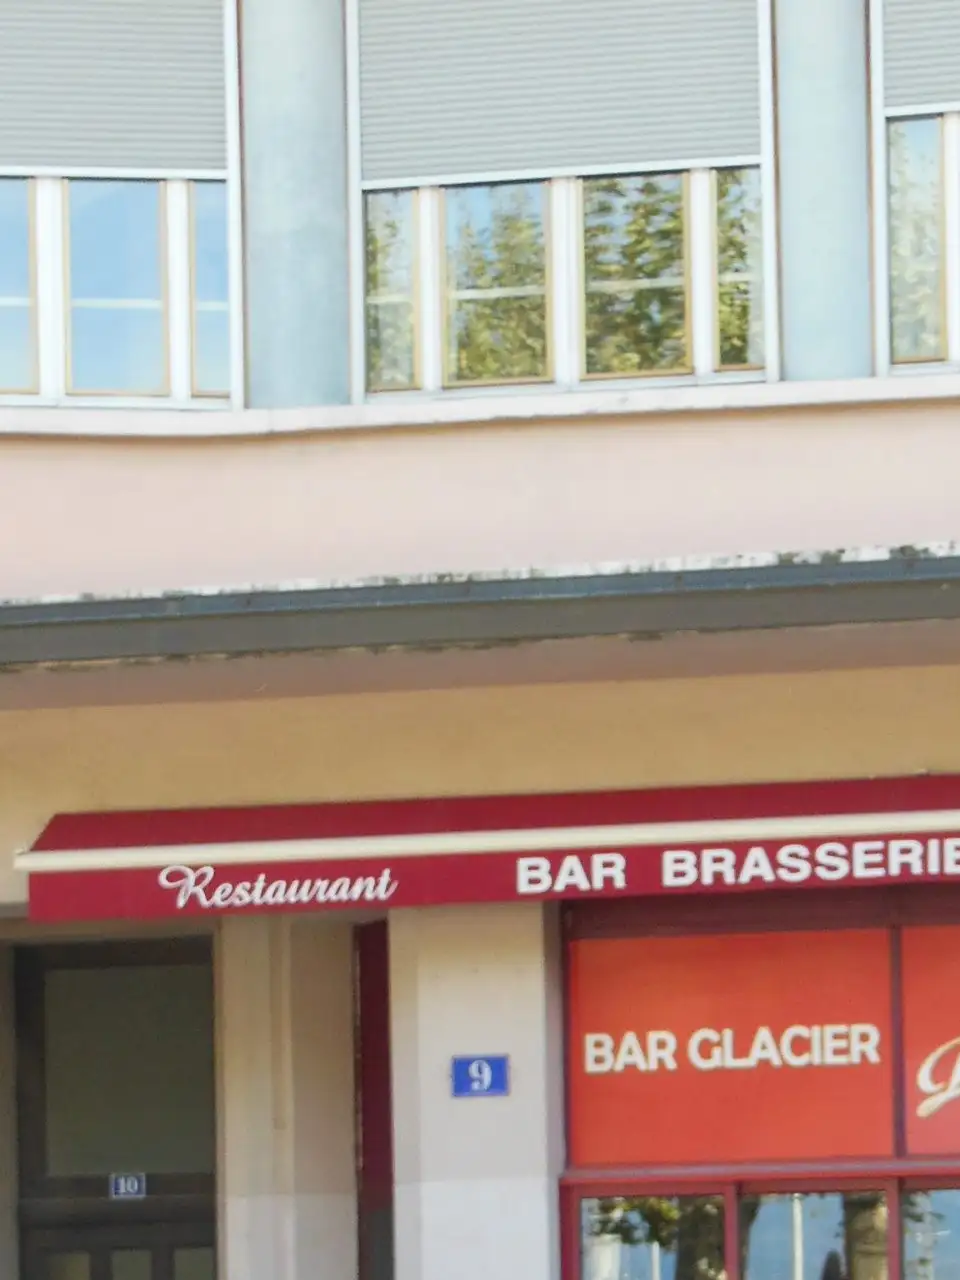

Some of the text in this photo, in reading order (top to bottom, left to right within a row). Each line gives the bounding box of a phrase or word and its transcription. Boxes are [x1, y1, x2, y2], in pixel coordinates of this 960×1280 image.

[157, 864, 398, 910] Restaurant
[515, 852, 627, 894] BAR
[584, 1023, 881, 1074] BAR GLACIER
[468, 1059, 493, 1092] 9
[118, 1176, 138, 1194] 10
